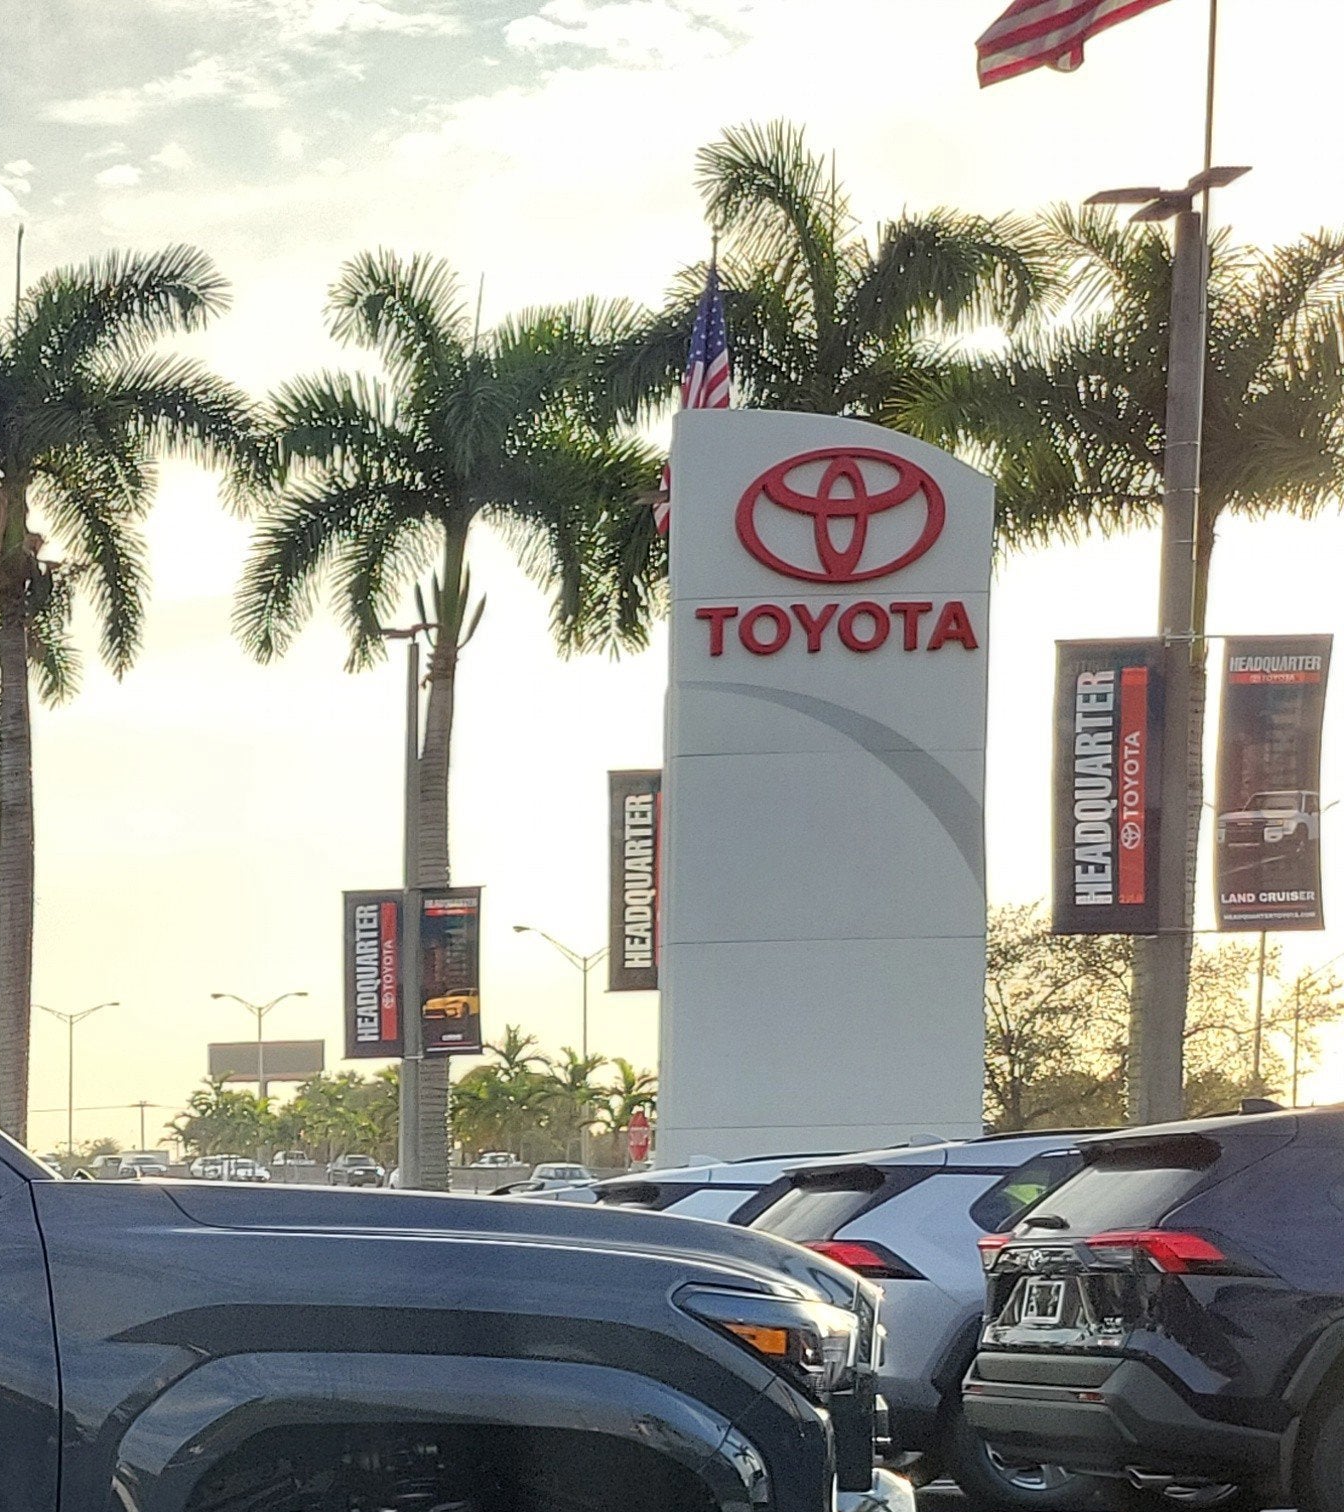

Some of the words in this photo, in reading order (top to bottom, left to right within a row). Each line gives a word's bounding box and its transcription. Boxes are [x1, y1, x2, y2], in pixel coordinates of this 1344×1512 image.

[695, 600, 979, 657] TOYOTA
[1229, 655, 1322, 673] HEADQUARTER
[1074, 670, 1118, 906] HEADQUARTER
[1123, 730, 1141, 820] TOYOTA
[624, 793, 656, 969] HEADQUARTER
[1220, 892, 1256, 904] LAND
[1258, 890, 1315, 903] CRUISER
[356, 903, 381, 1042] HEADQUARTER
[382, 939, 394, 992] TOYOTA
